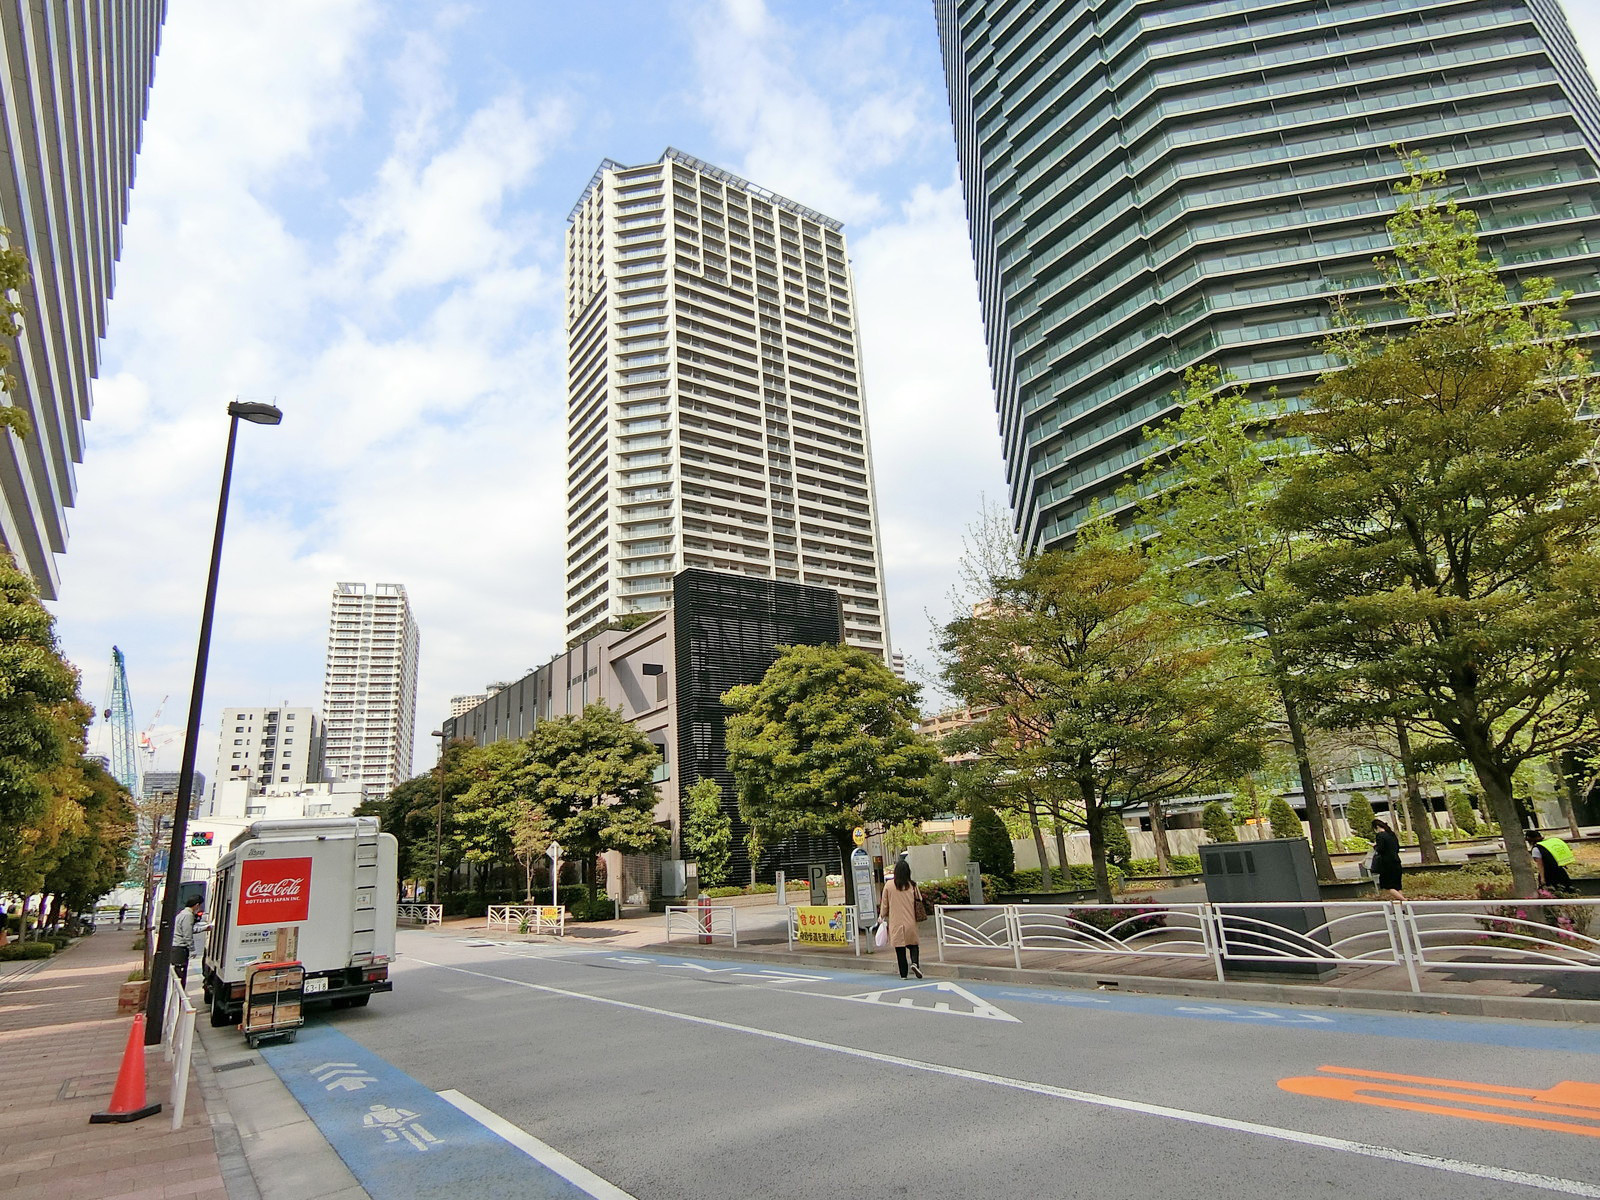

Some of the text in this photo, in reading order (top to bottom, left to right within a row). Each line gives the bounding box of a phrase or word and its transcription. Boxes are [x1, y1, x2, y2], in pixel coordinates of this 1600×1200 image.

[246, 878, 304, 898] Coca-Cola
[811, 867, 823, 891] P
[800, 914, 826, 926] 危ない
